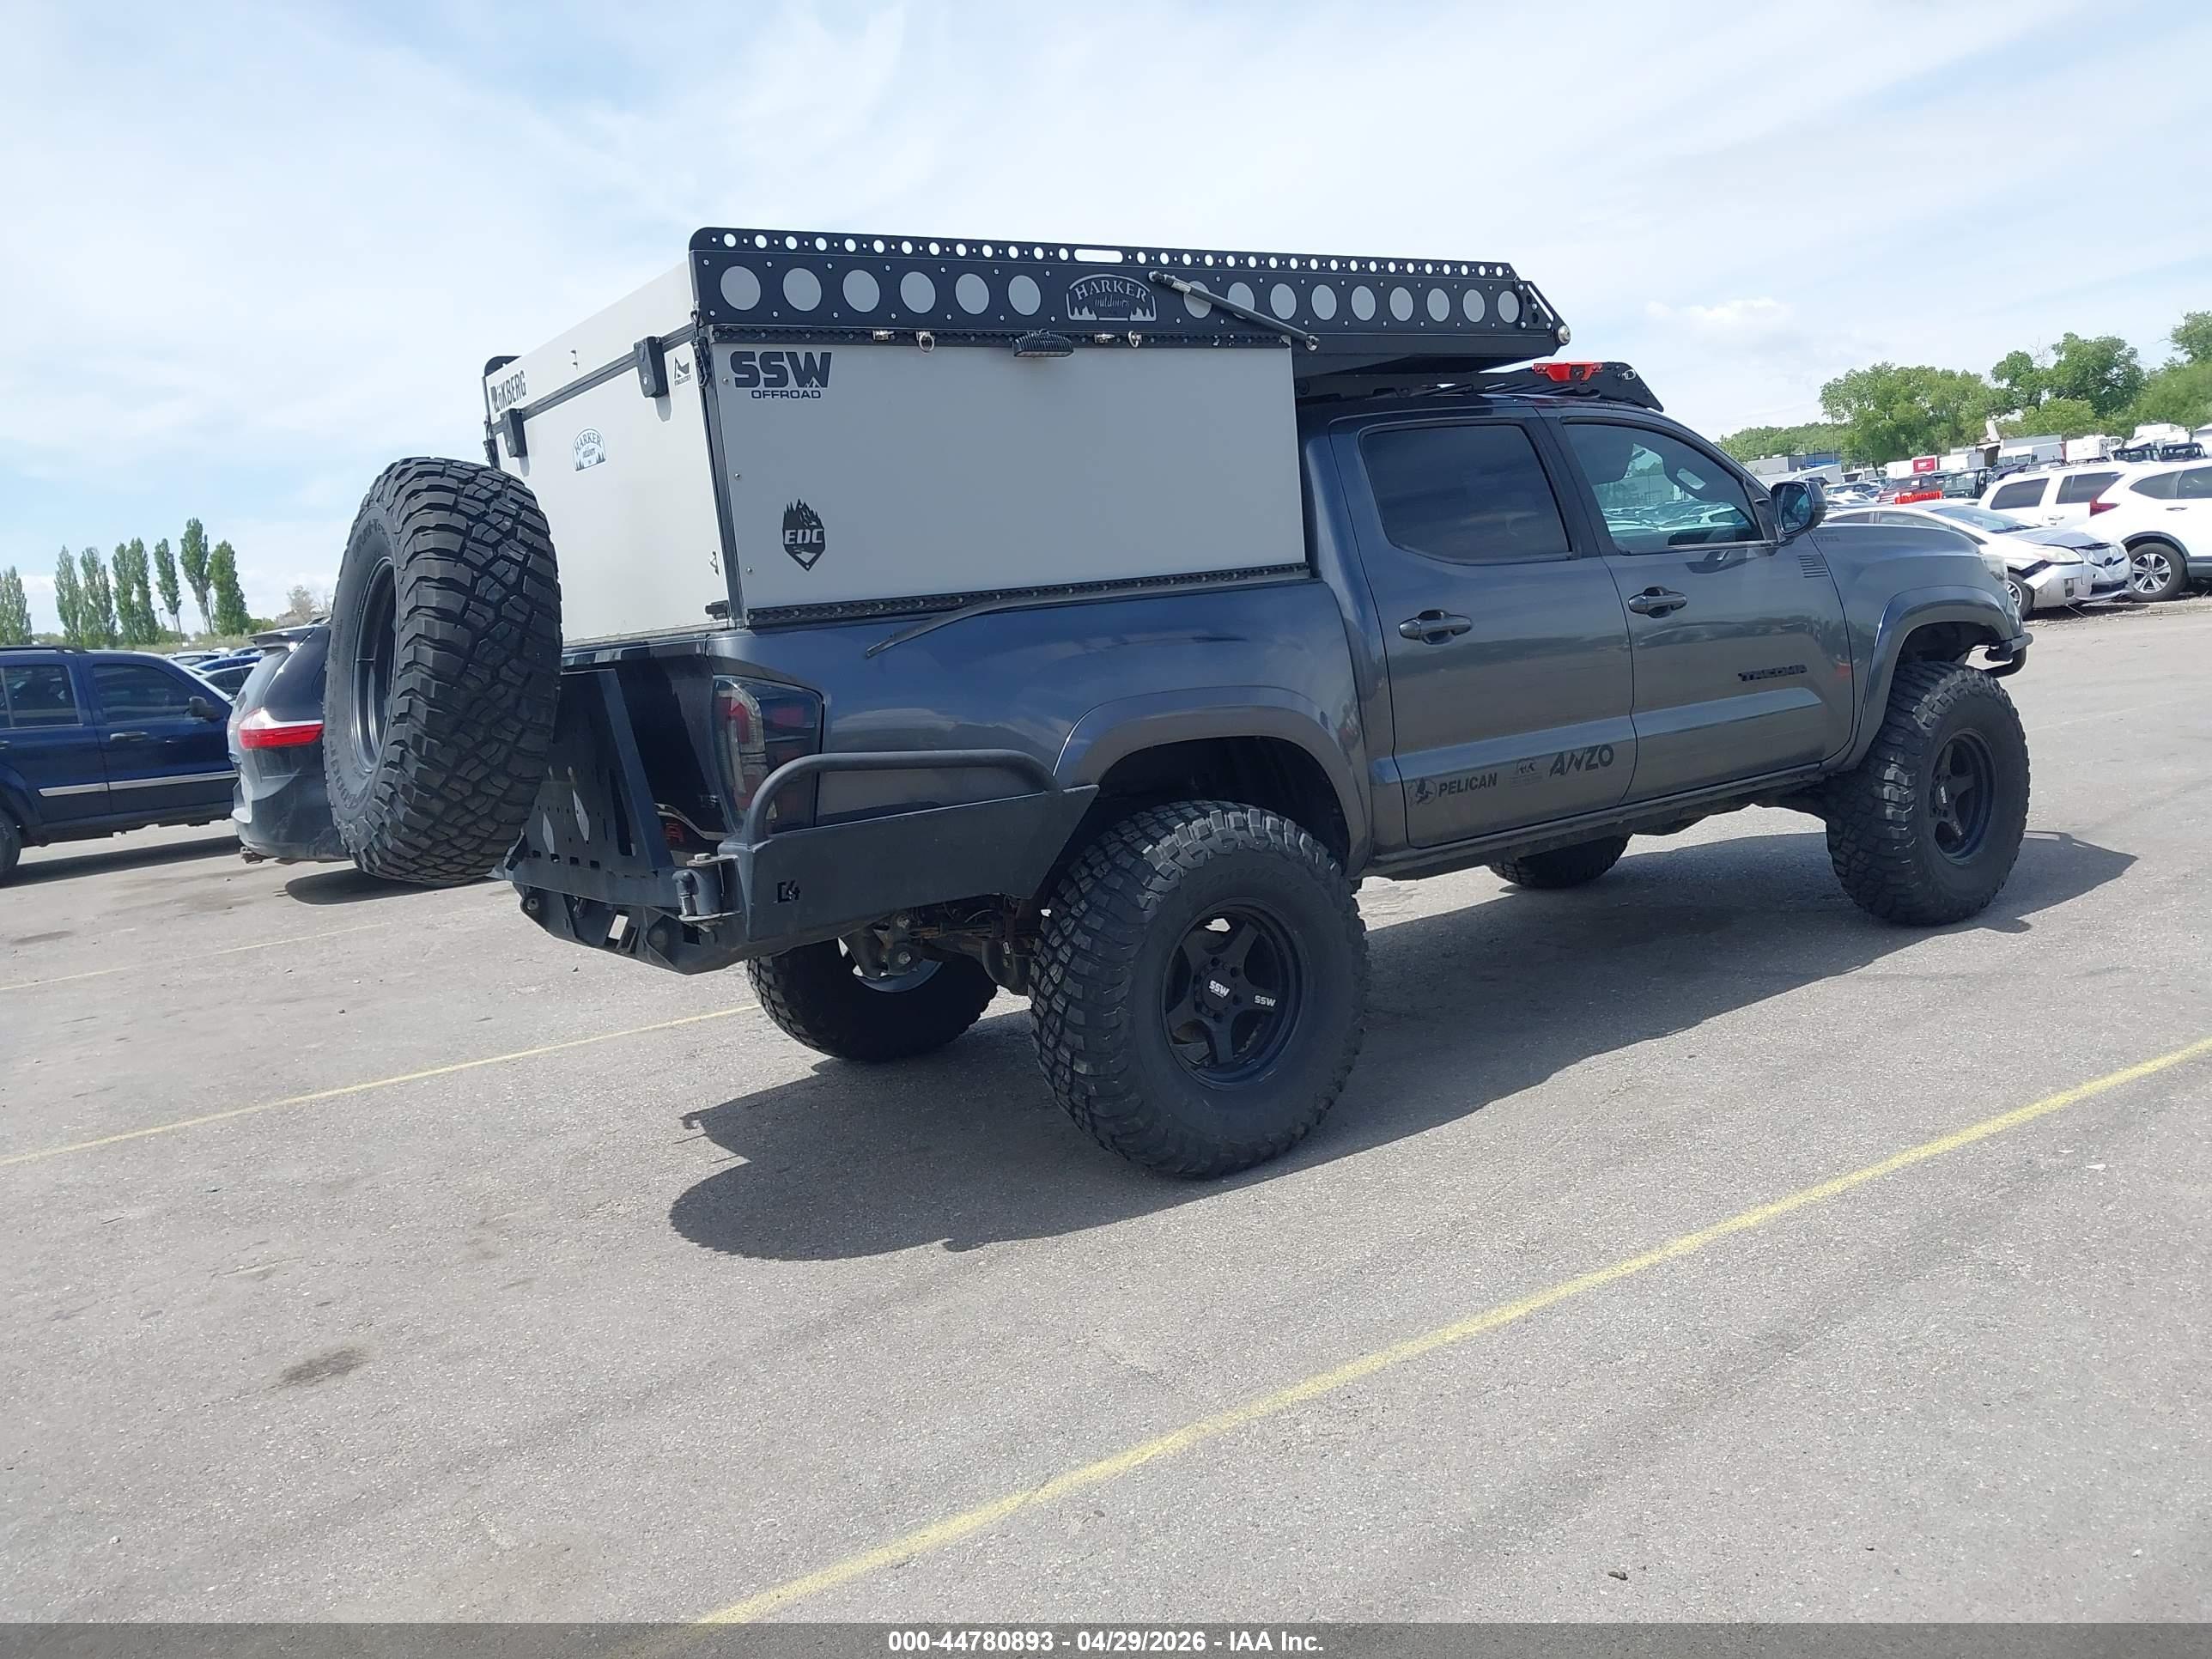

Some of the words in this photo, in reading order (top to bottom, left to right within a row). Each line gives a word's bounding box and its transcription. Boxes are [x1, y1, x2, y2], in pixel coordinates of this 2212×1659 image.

[1074, 279, 1146, 302] HARKER
[729, 350, 832, 388] SSW
[750, 390, 822, 399] OFFROAD
[575, 432, 602, 455] HARKER
[784, 528, 823, 545] EDC
[1550, 744, 1614, 777] ANZO
[1438, 773, 1498, 797] PELICAN
[1209, 980, 1230, 997] SSW
[1255, 994, 1276, 1007] SSW
